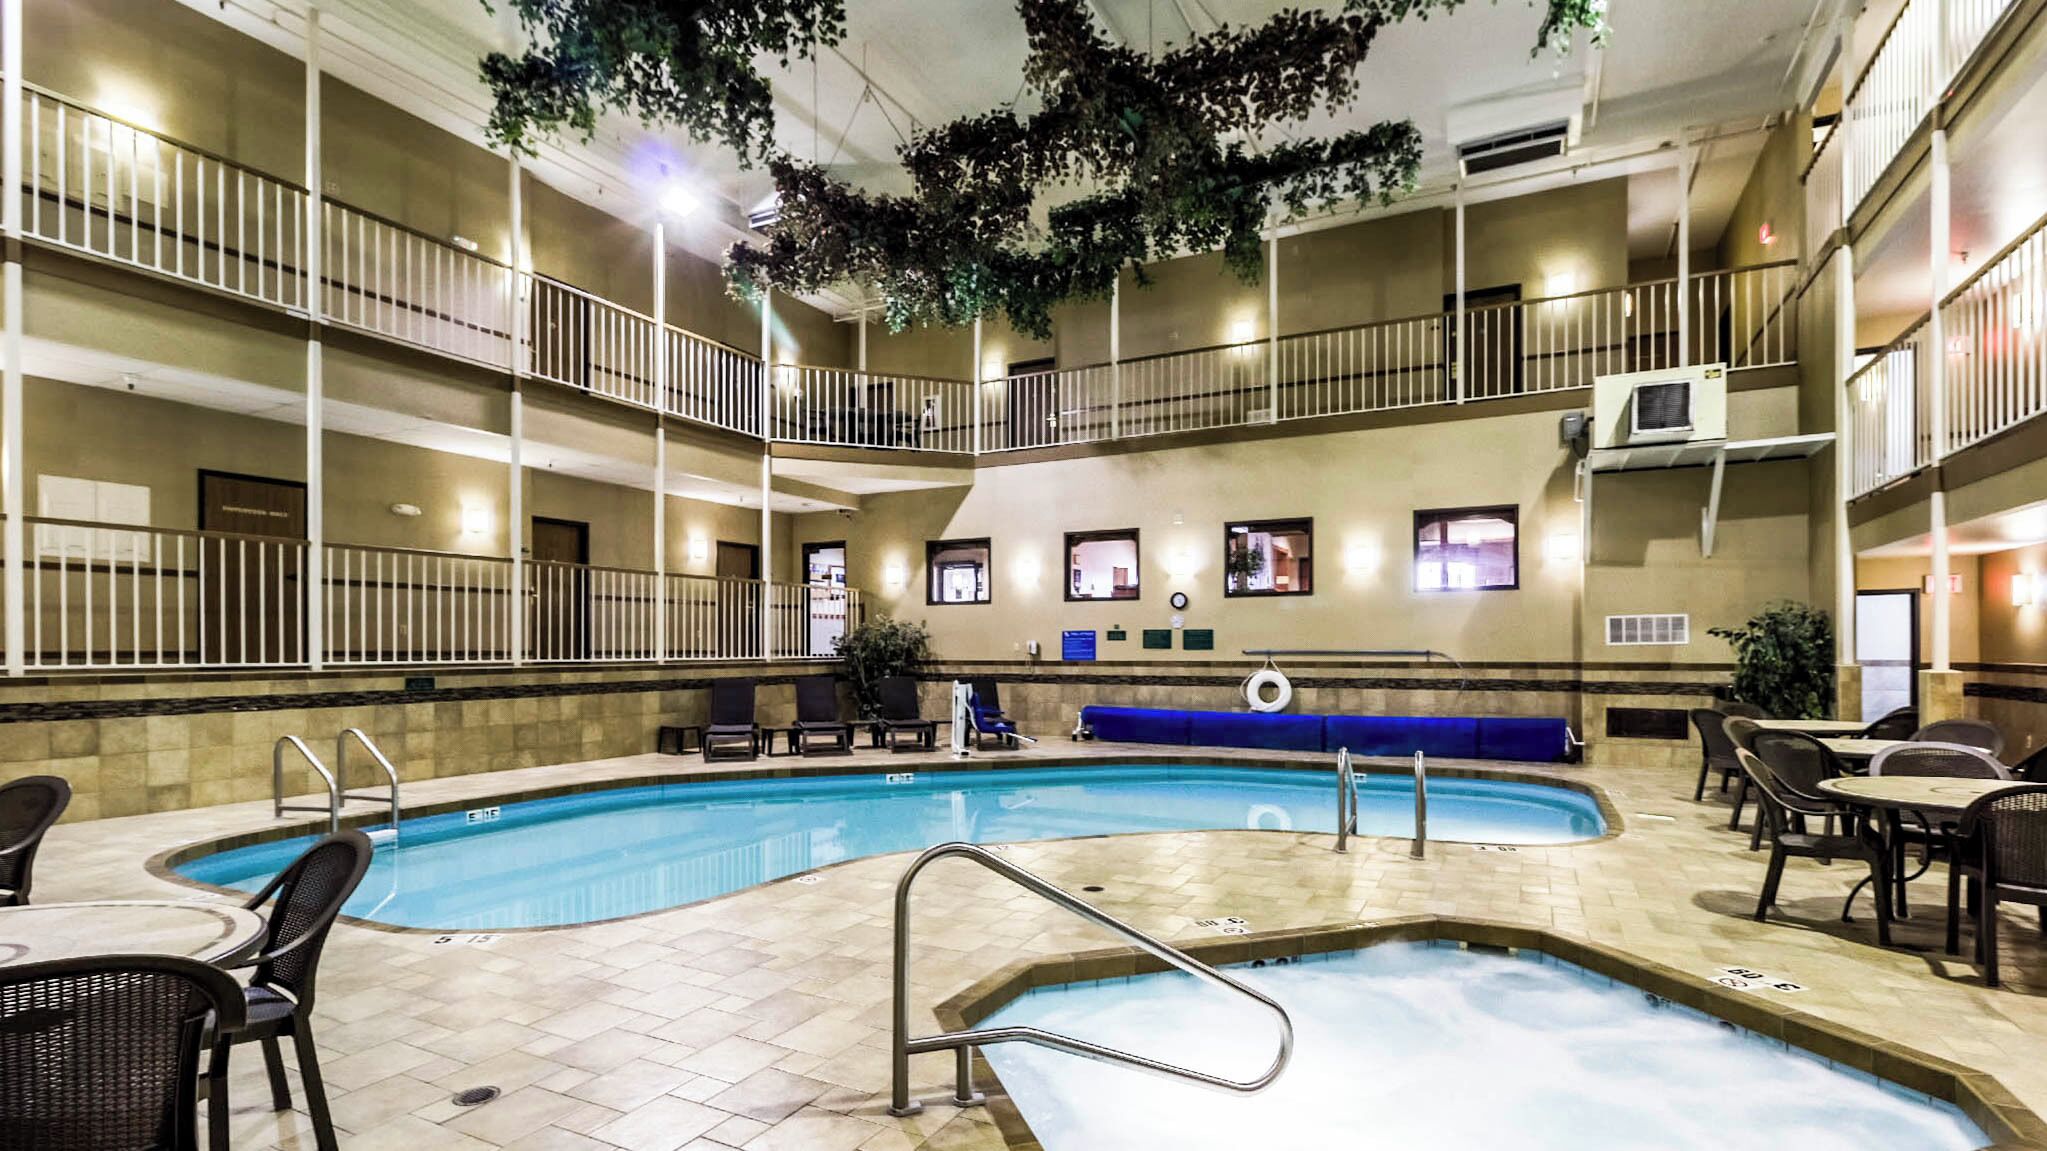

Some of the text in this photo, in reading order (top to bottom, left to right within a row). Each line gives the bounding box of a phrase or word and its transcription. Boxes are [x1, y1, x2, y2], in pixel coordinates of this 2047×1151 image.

[433, 934, 496, 944] 5 15
[1773, 983, 1801, 992] 3
